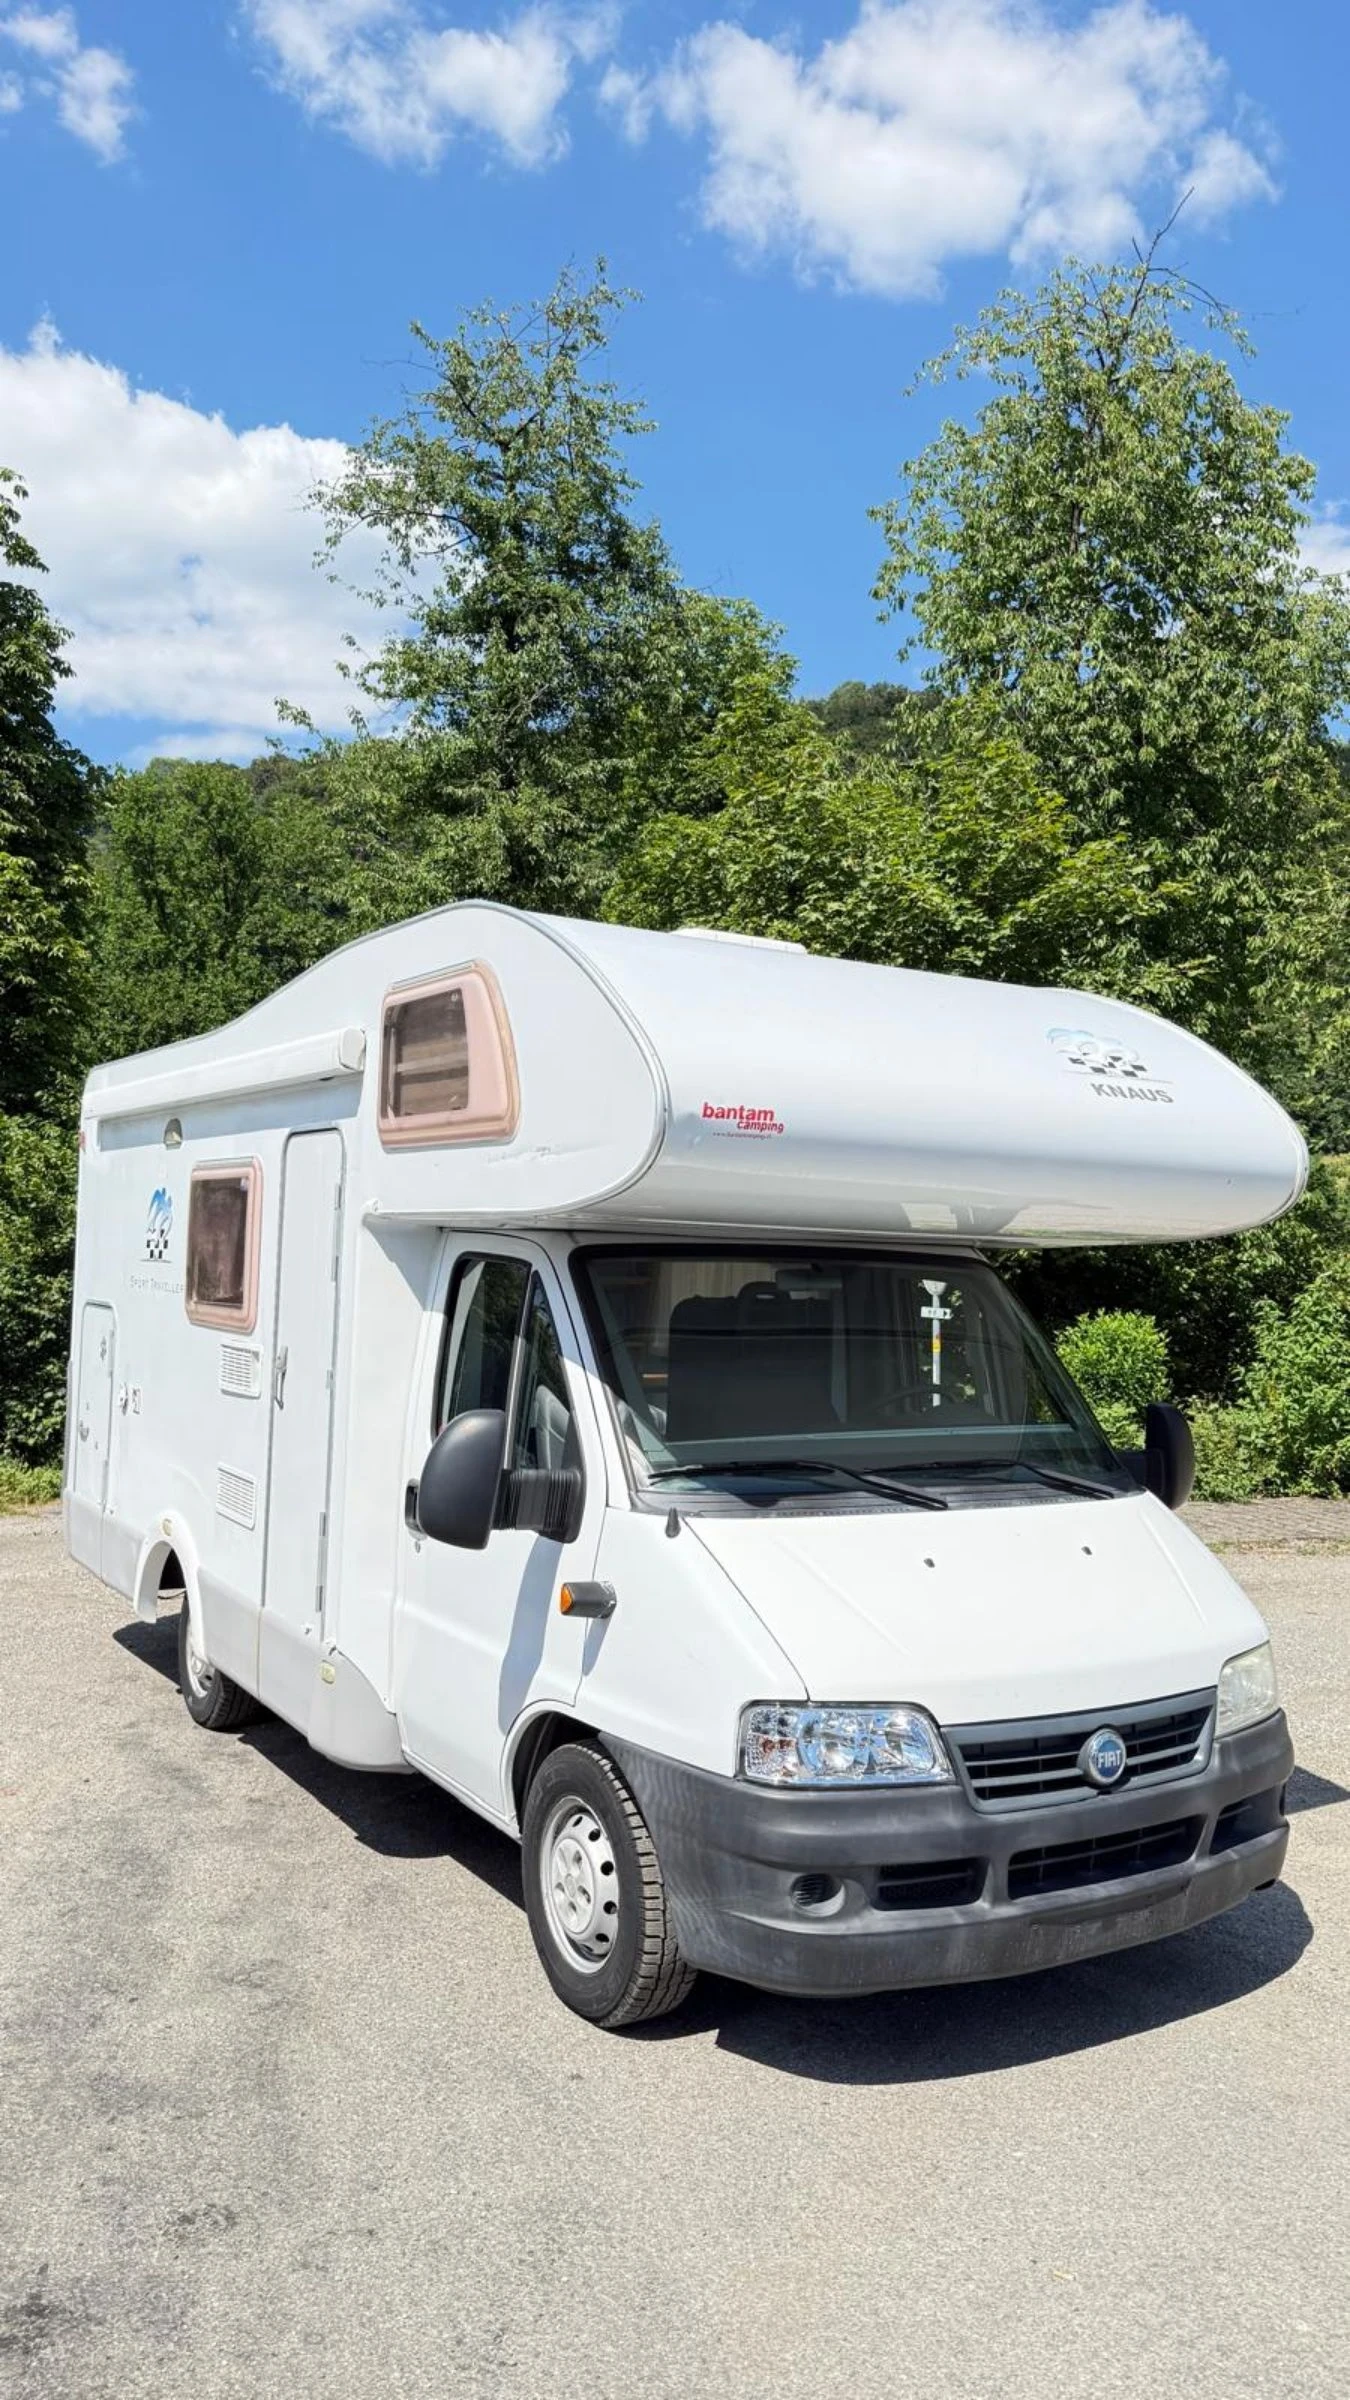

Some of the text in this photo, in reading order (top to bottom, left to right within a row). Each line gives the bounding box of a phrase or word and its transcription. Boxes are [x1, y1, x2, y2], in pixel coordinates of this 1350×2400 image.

[1090, 1082, 1174, 1103] KNAUS
[702, 1102, 775, 1121] bantam
[737, 1120, 784, 1133] camping
[1097, 1749, 1121, 1769] FIAT
